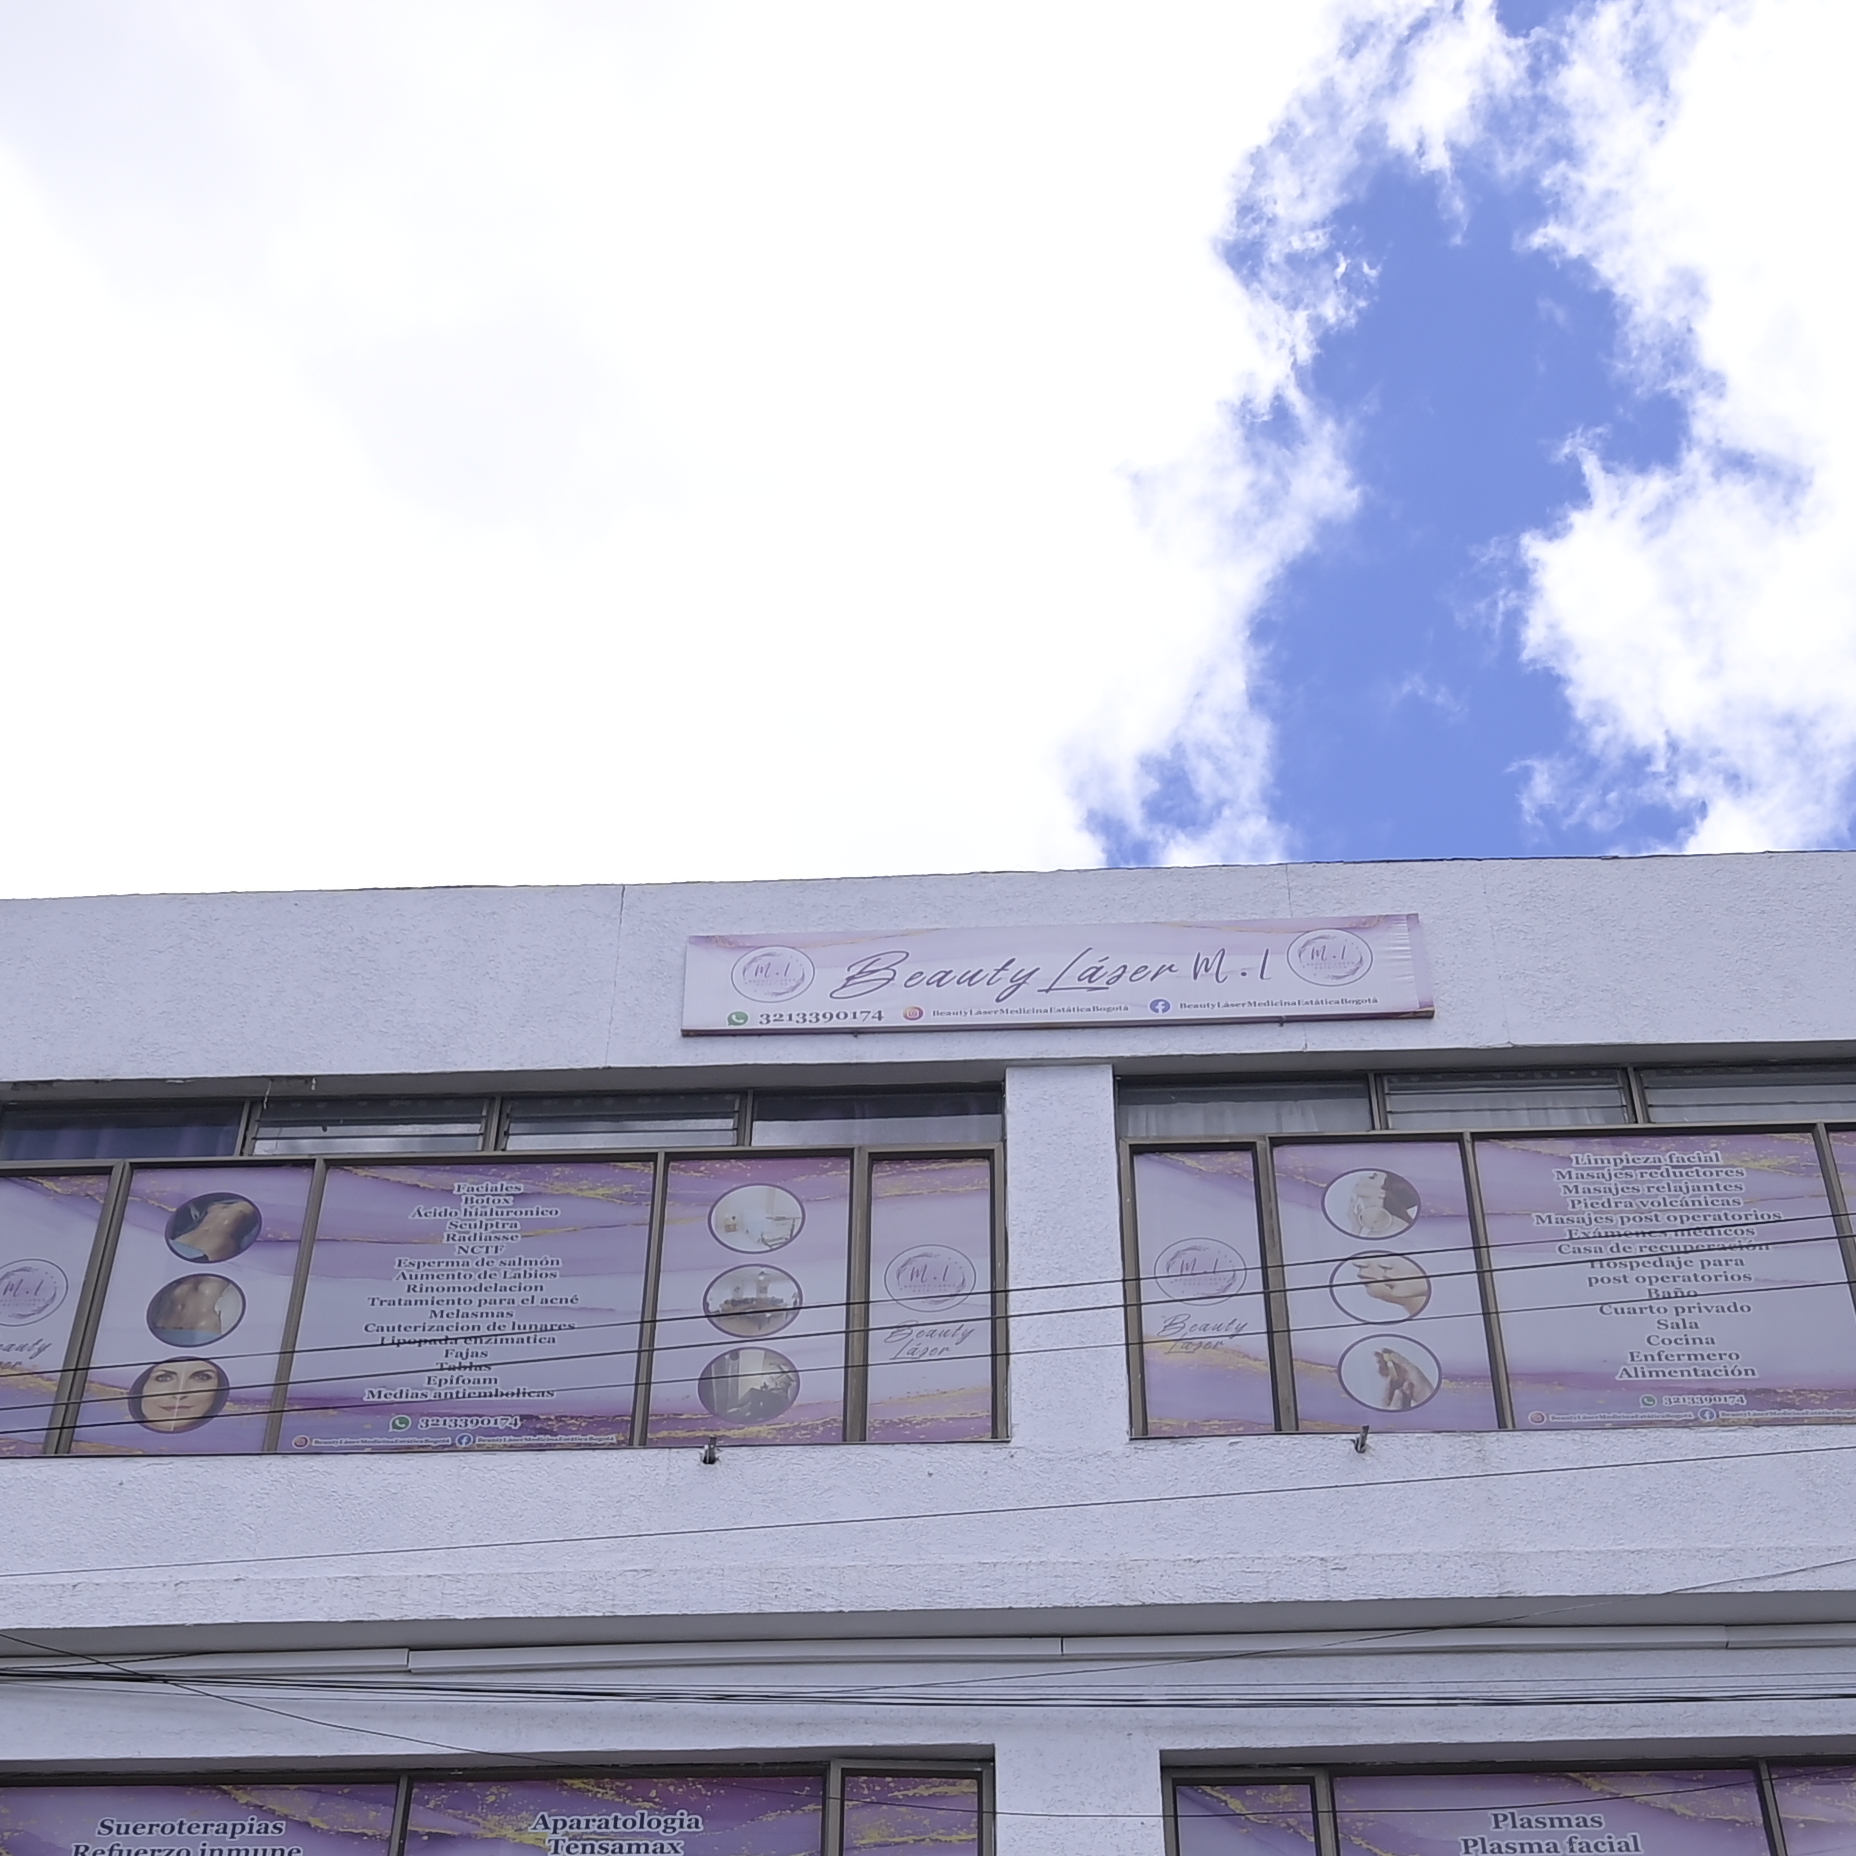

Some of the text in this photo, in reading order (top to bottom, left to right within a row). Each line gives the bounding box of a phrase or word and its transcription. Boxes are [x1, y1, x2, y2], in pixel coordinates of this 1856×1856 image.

[830, 950, 1041, 1003] Beauty
[1037, 947, 1180, 993] Láser
[758, 1009, 885, 1025] 3213390174
[1555, 1167, 1745, 1182] Masajes reductores
[1562, 1182, 1744, 1196] Masajes relajantes
[447, 1219, 519, 1231] Sculptra
[429, 1309, 514, 1319] Melasmas
[1598, 1301, 1753, 1317] Cuarto privado
[1156, 1312, 1249, 1340] Beauty
[1655, 1318, 1701, 1330] Sala
[884, 1319, 976, 1346] Beauty
[1646, 1334, 1716, 1346] Cocina
[1628, 1350, 1741, 1363] Enfermero
[1618, 1365, 1757, 1379] Alimentación
[96, 1816, 286, 1840] Sueroterapias
[531, 1812, 702, 1836] Aparatologia
[1492, 1811, 1603, 1831] Plasmas
[547, 1837, 684, 1856] Tensamax
[1461, 1834, 1642, 1856] Plasma facial
